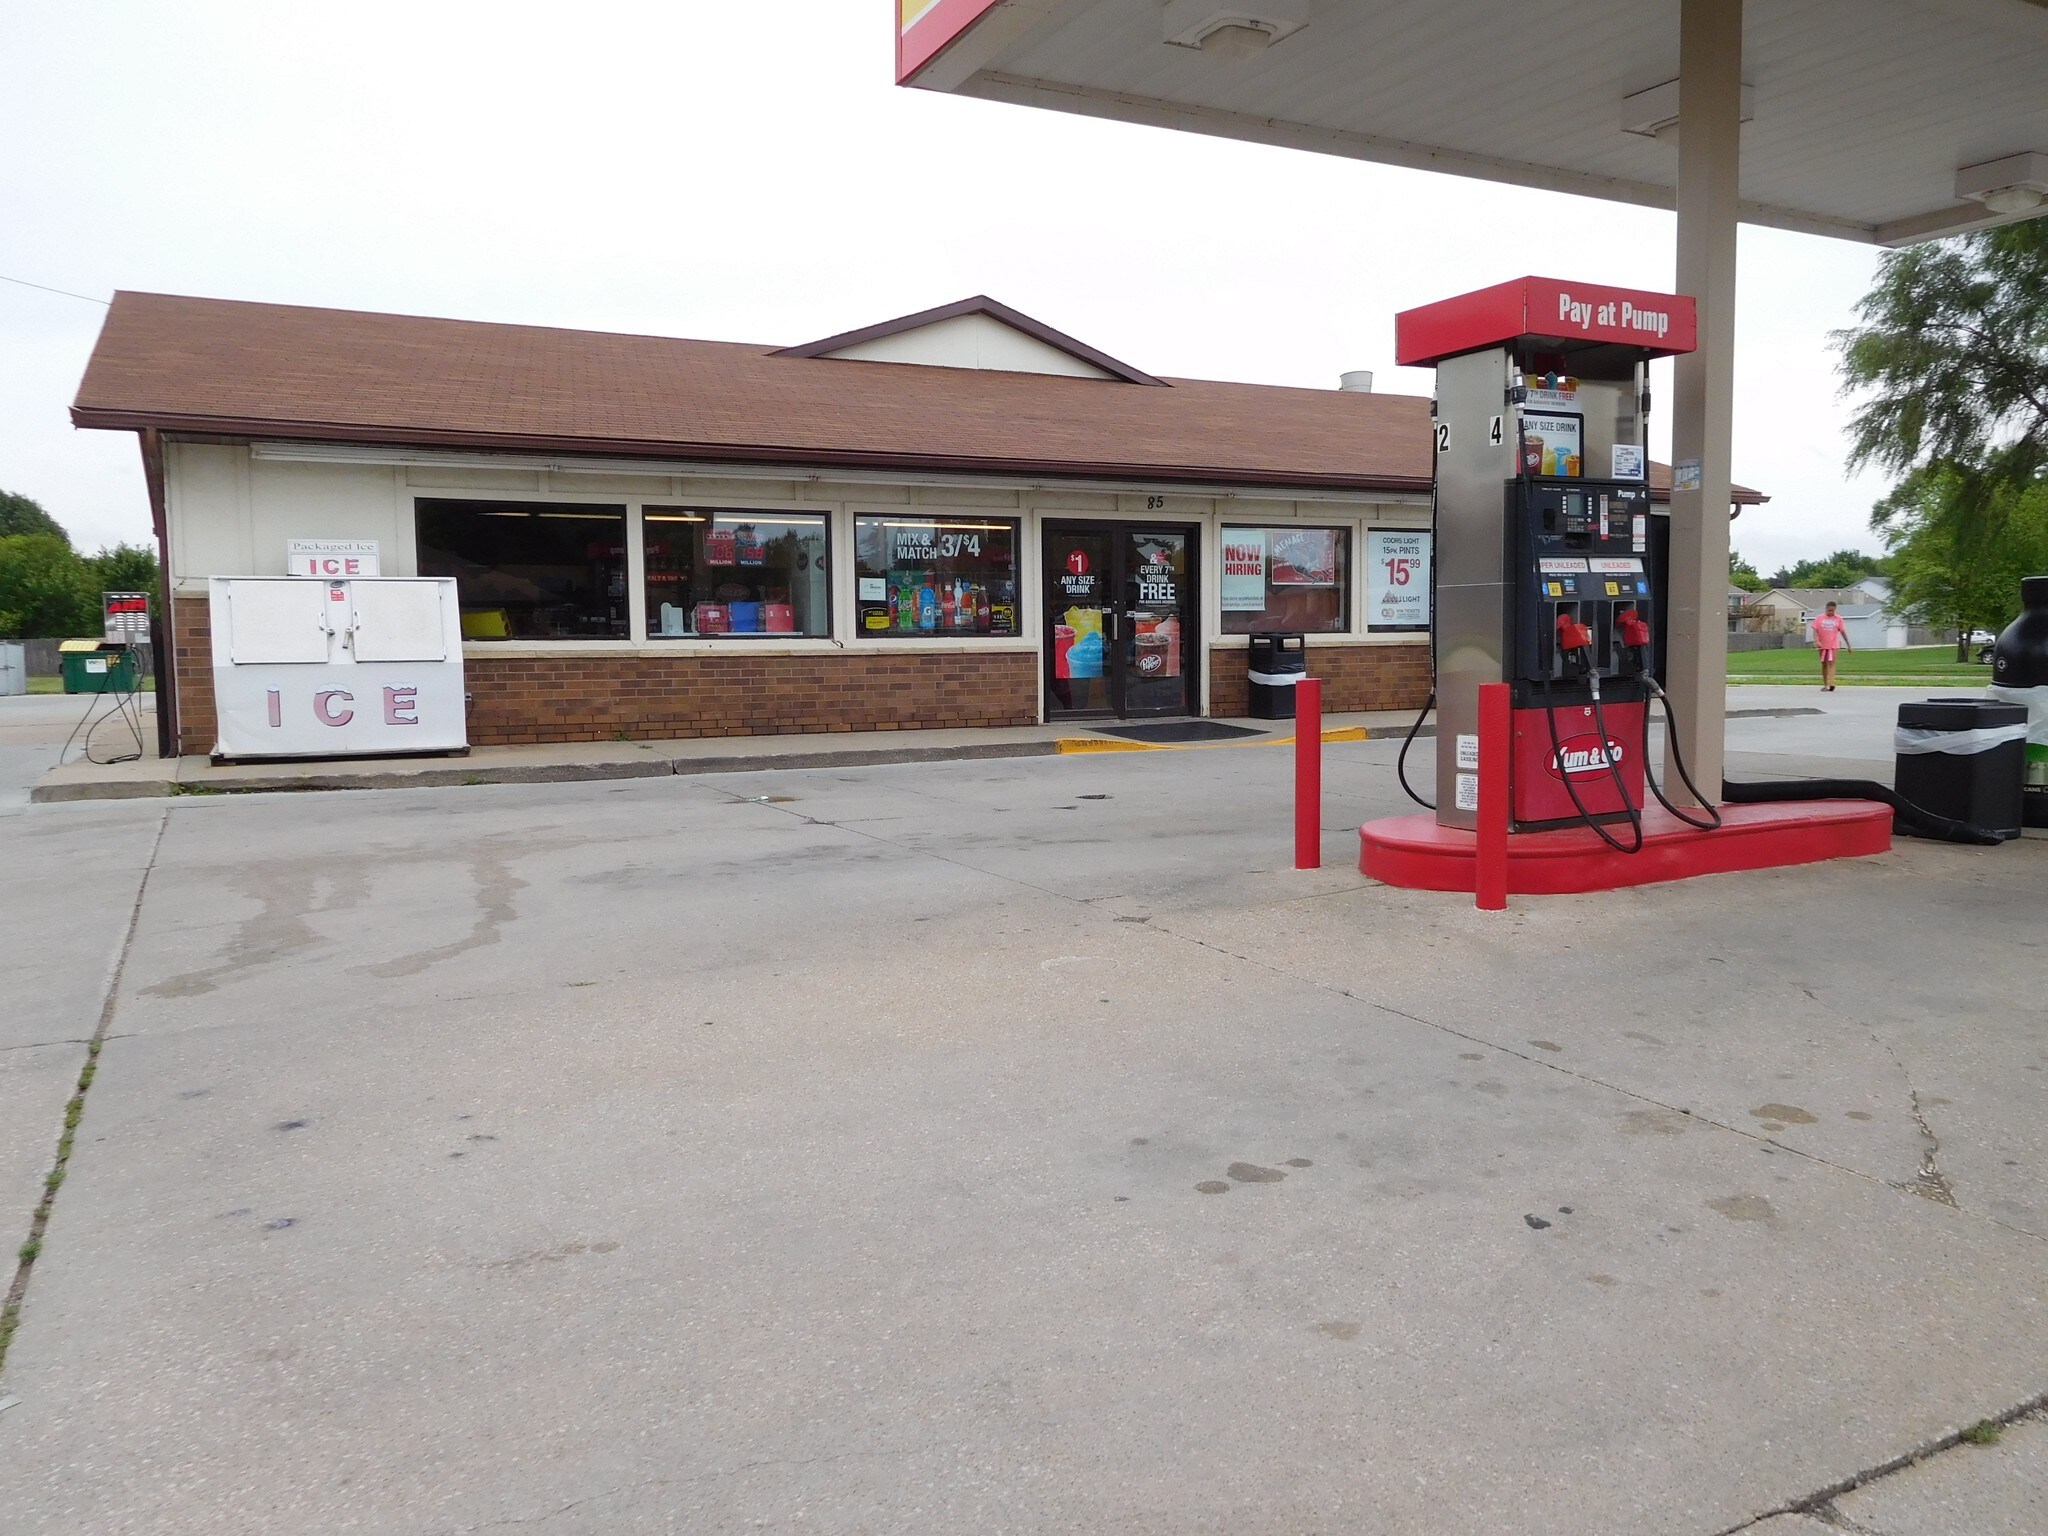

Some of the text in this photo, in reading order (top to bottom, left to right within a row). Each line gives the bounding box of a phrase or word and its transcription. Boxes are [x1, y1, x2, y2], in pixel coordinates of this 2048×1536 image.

[1559, 293, 1669, 339] Pay at Pump
[1540, 391, 1559, 400] DRINK
[1559, 392, 1575, 402] FREE!
[1491, 416, 1502, 444] 4
[1525, 421, 1577, 433] ANY SIZE DRINK
[1439, 424, 1449, 452] 2
[1617, 489, 1646, 500] Pump 4
[1147, 495, 1164, 510] 85
[896, 532, 932, 546] MIX &
[941, 533, 981, 557] 3/$4
[1382, 537, 1420, 545] COORS LIGHT
[293, 542, 374, 552] Packaged Ice
[896, 546, 938, 560] MATCH
[1225, 544, 1262, 562] NOW
[1398, 546, 1420, 555] PINTS
[1070, 554, 1084, 573] $1
[1149, 553, 1158, 565] &
[1555, 561, 1586, 569] UNLEADED
[1600, 561, 1632, 569] UNLEADED
[309, 559, 360, 575] ICE
[1140, 565, 1164, 575] EVERY
[1225, 563, 1262, 576] HIRING
[1060, 575, 1096, 585] ANY SIZE
[1146, 574, 1169, 584] DRINK
[1066, 584, 1091, 594] DRINK
[1139, 583, 1176, 600] FREE
[923, 606, 931, 615] G
[267, 683, 419, 728] ICE
[1589, 747, 1601, 765] &
